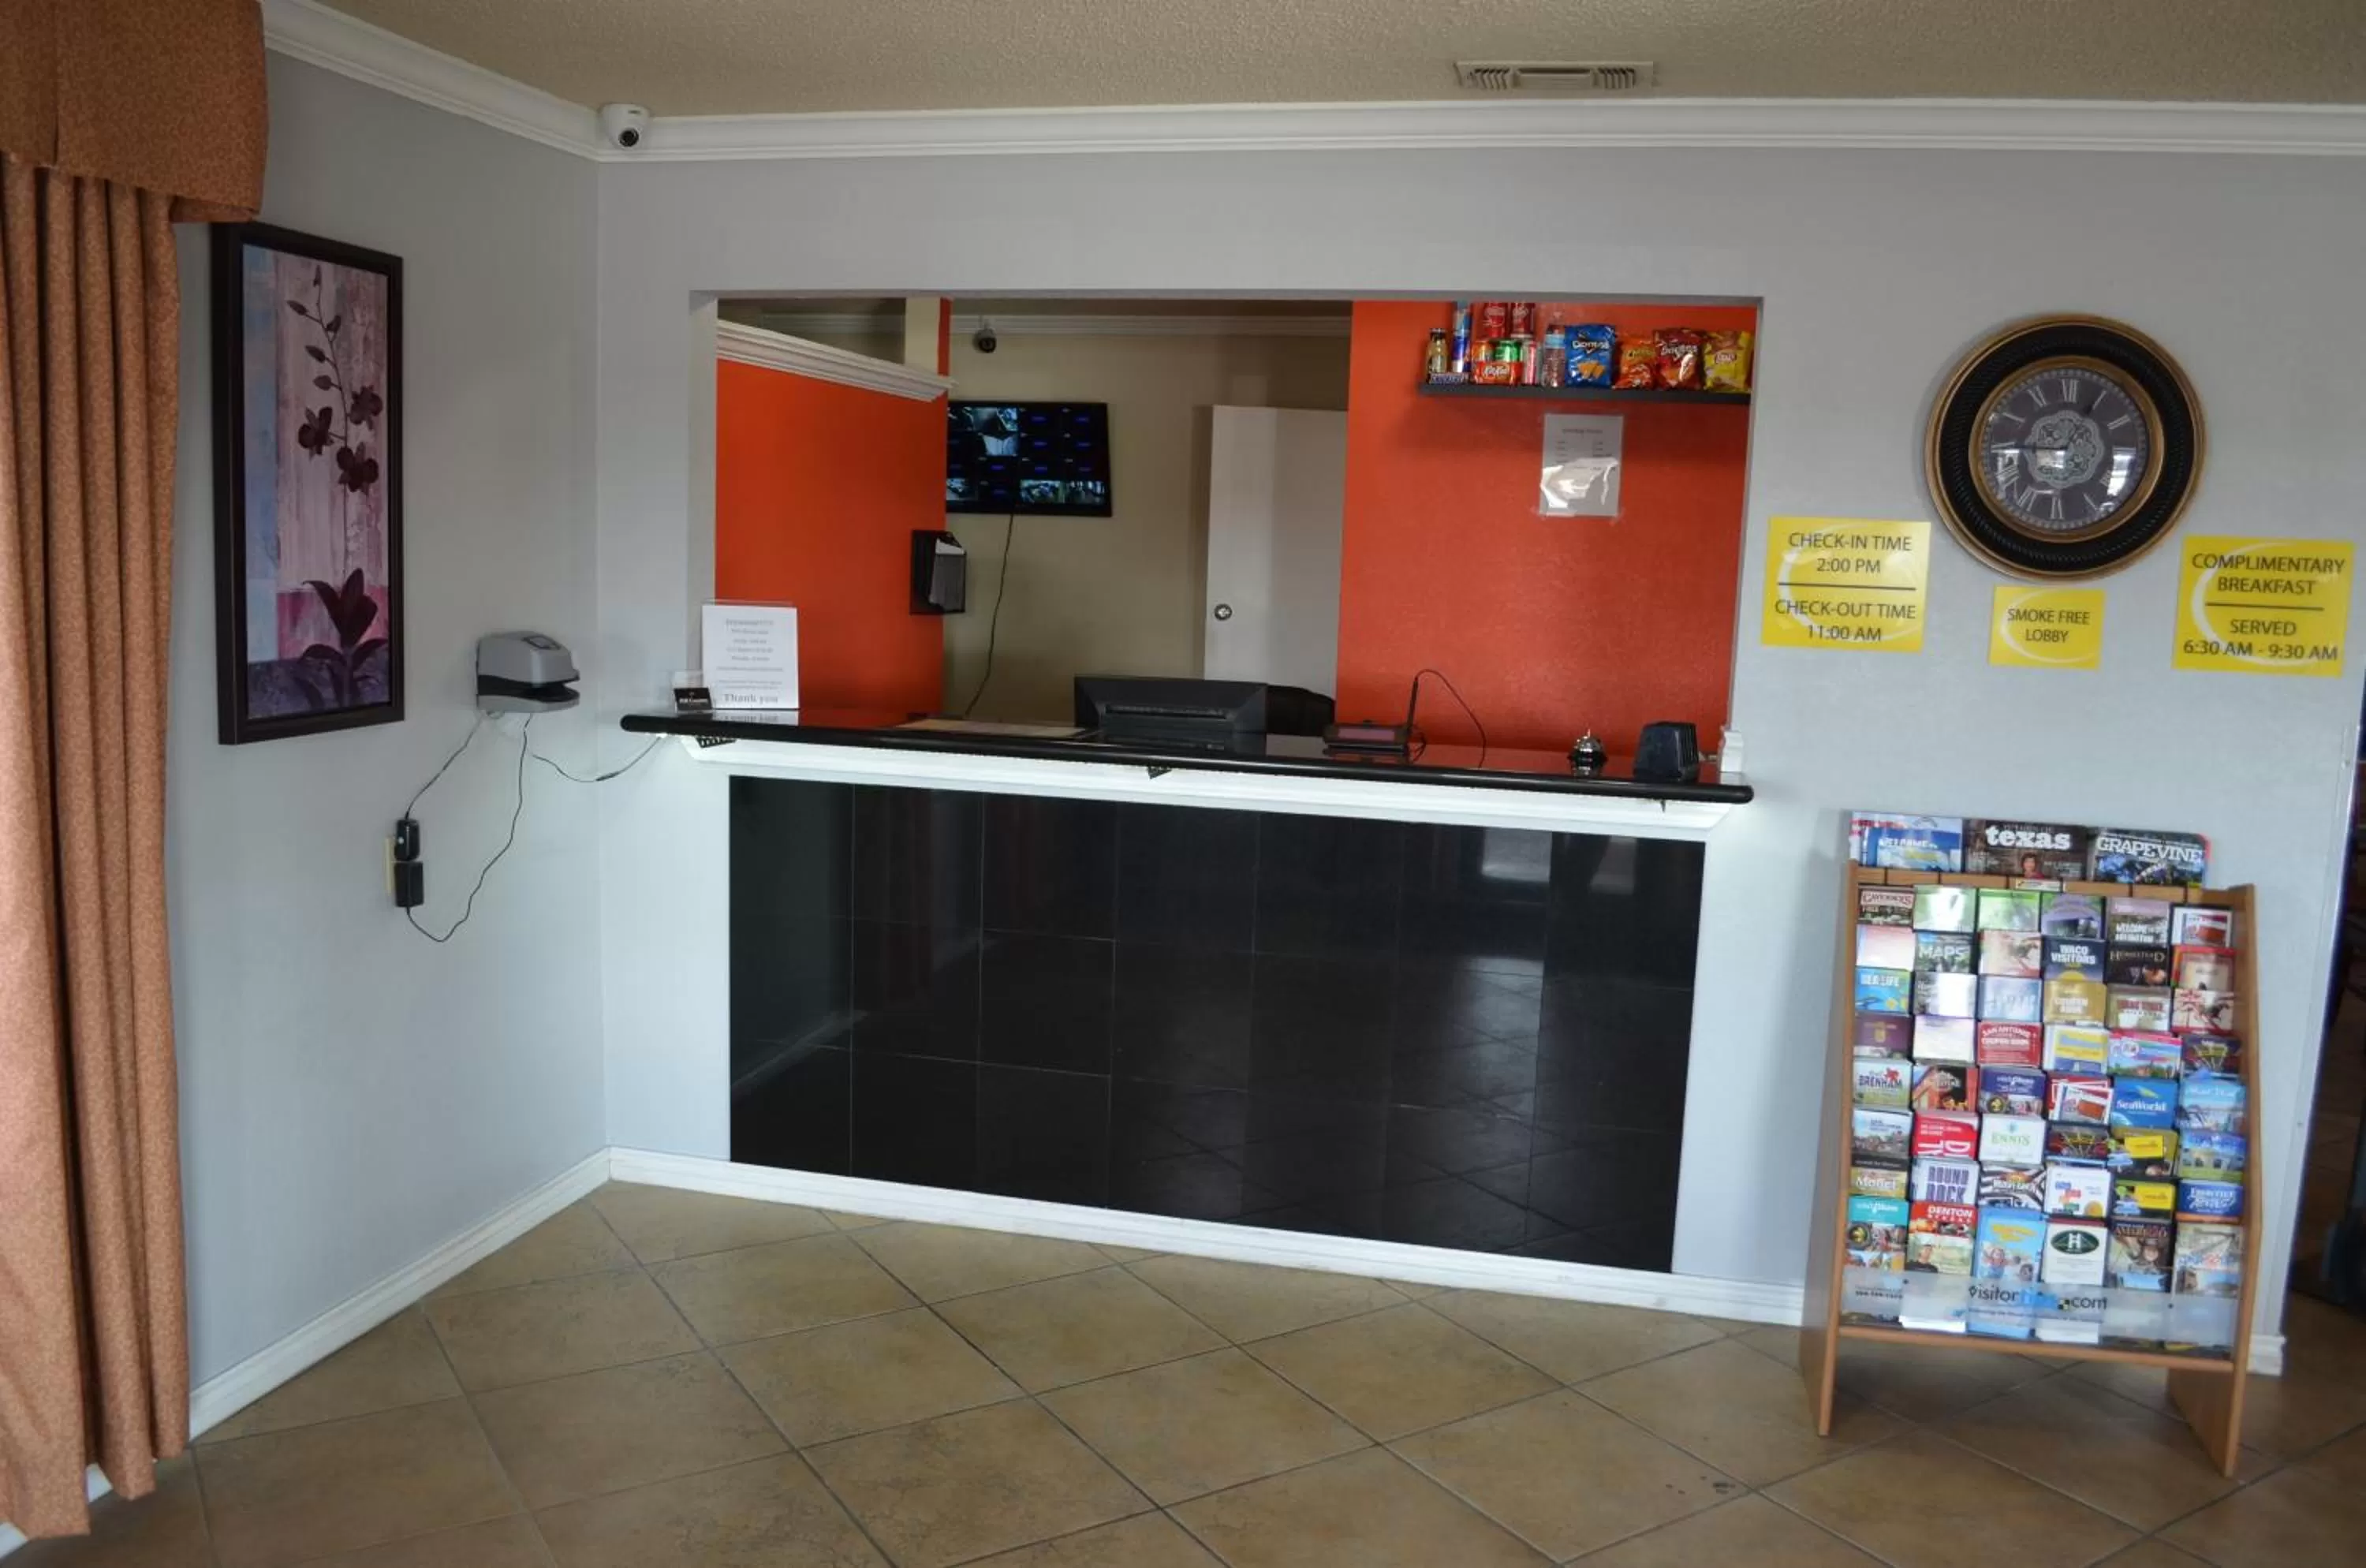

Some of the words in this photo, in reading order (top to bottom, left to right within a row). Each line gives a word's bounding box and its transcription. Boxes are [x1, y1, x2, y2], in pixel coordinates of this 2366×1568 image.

[1788, 532, 1868, 550] CHECK-IN
[1872, 536, 1913, 551] TIME
[1816, 558, 1851, 573] 2:00
[1855, 558, 1881, 574] PM
[2192, 553, 2345, 575] COMPLIMENTARY
[2218, 577, 2316, 595] BREAKFAST
[1774, 599, 1875, 618] CHECK-OUT
[1875, 603, 1916, 619] TIME
[2007, 608, 2054, 624] SMOKE
[2058, 610, 2091, 625] FREE
[1808, 624, 1850, 640] 11:00
[1853, 627, 1882, 642] AM
[2025, 628, 2070, 643] LOBBY
[2230, 618, 2297, 637] SERVED
[2183, 640, 2220, 655] 6:30
[2223, 641, 2252, 657] AM
[2268, 643, 2304, 659] 9:30
[2308, 645, 2338, 661] AM
[724, 693, 757, 703] Thank
[759, 694, 778, 704] you
[1985, 825, 2071, 850] texas
[2096, 836, 2204, 863] GRAPEVINE
[1918, 946, 1970, 960] MAPS
[2051, 952, 2096, 965] VISITORS
[2059, 944, 2089, 955] WACO
[1858, 1074, 1903, 1088] BRENHAM
[2116, 1099, 2168, 1112] SeaWorld
[1928, 1165, 1970, 1184] ROUND
[1926, 1183, 1967, 1204] ROCK
[1928, 1206, 1973, 1218] DENTON
